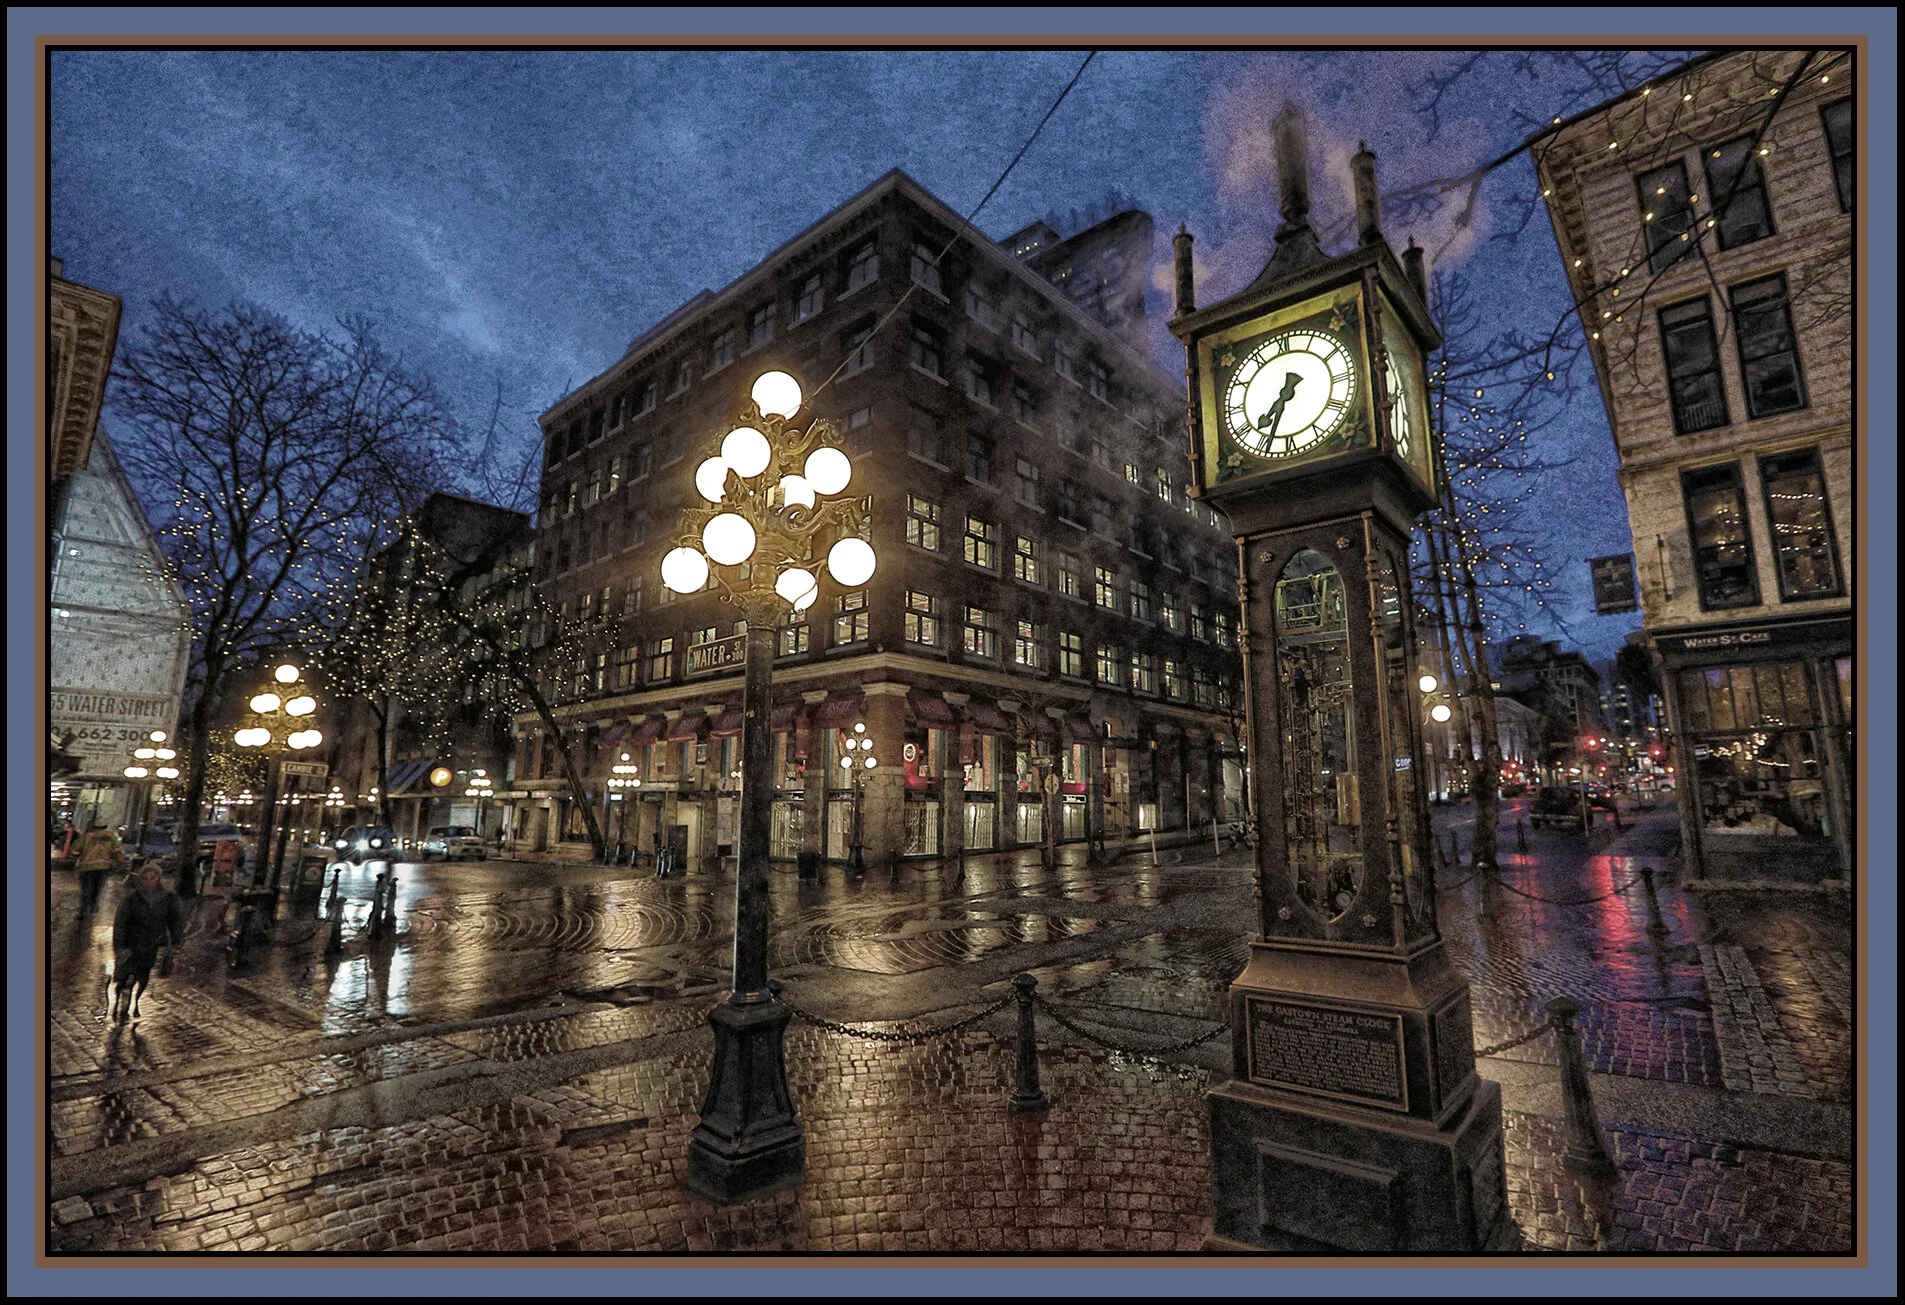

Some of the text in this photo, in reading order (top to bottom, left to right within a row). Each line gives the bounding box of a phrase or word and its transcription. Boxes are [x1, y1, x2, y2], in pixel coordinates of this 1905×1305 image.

[693, 645, 725, 669] WATER
[731, 650, 744, 661] 300
[68, 695, 116, 714] WATER
[119, 698, 166, 717] STREET
[78, 727, 113, 740] 662
[1256, 1004, 1391, 1031] THE GASTOWN STEAM CLOCK
